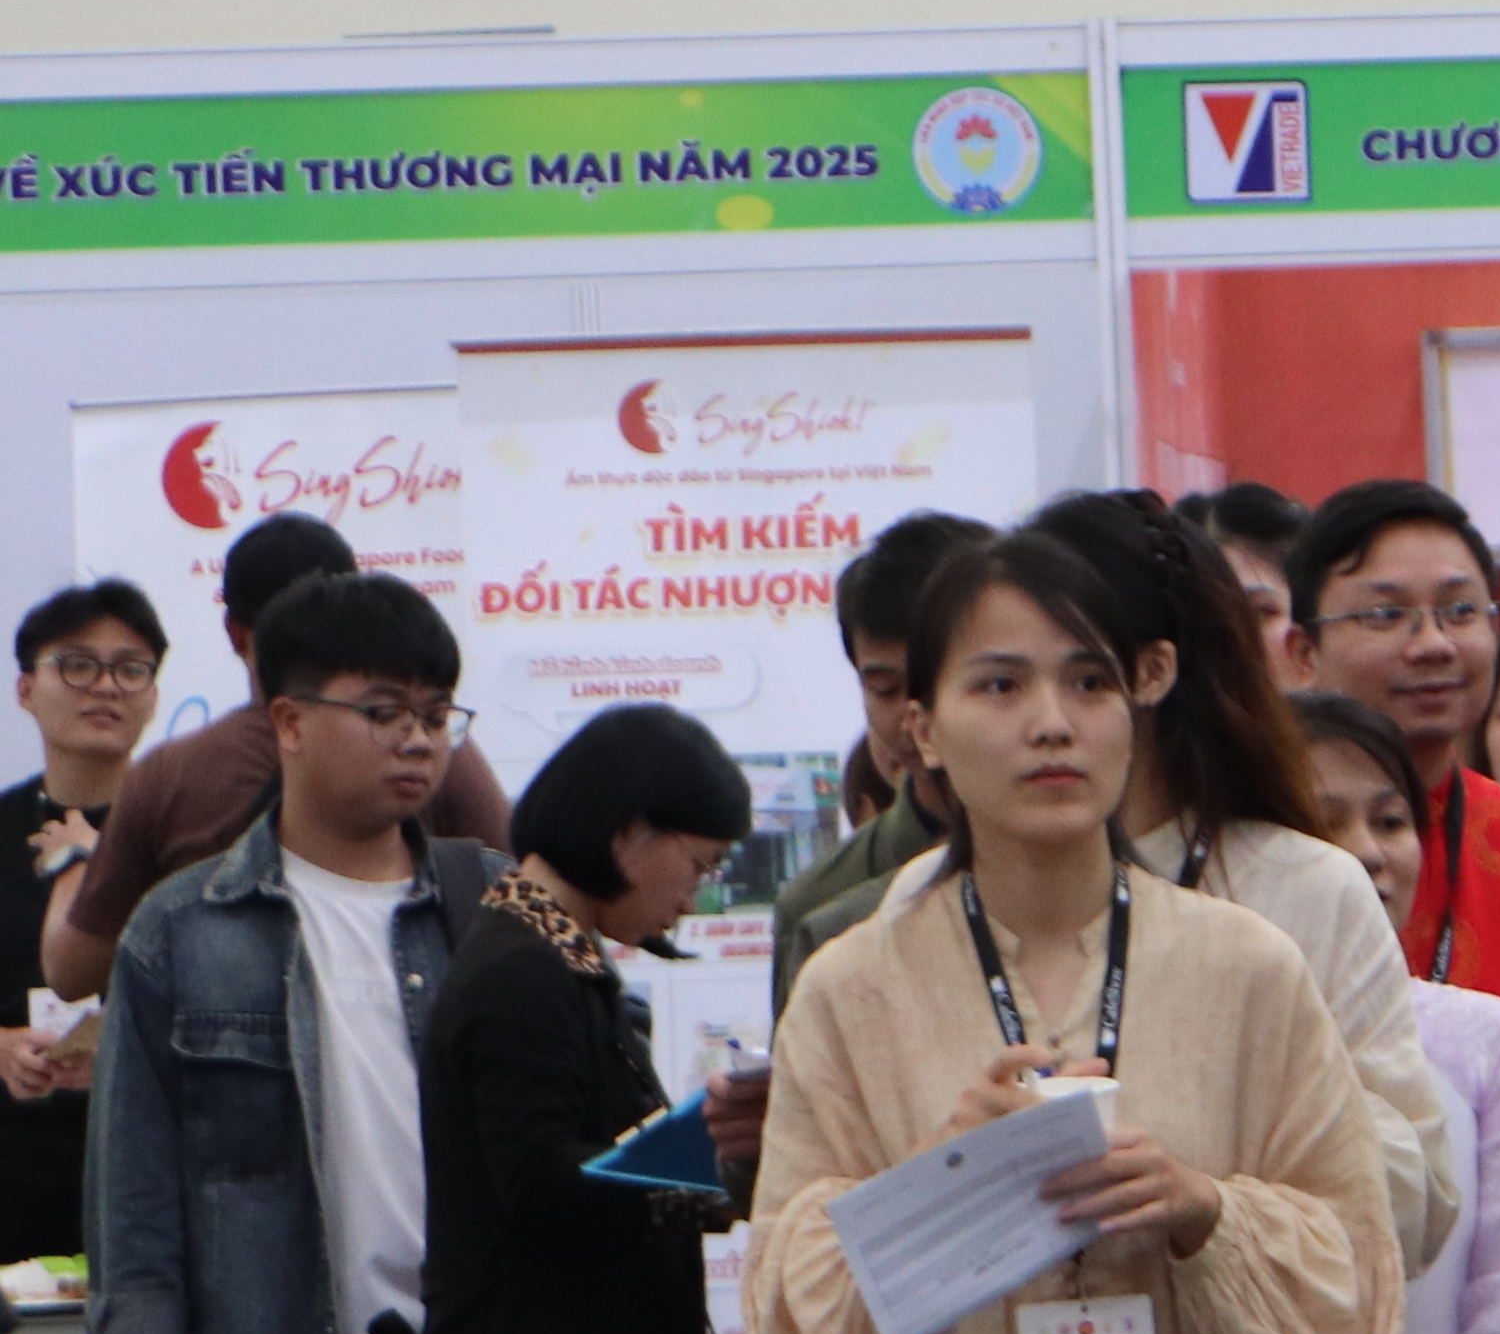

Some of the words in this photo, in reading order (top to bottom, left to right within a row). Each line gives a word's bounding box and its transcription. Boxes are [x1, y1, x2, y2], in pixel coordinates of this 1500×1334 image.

[56, 155, 156, 198] XÚC
[173, 147, 285, 195] TIẾN
[301, 150, 512, 191] THƯƠNG
[529, 151, 621, 196] MẠI
[638, 140, 752, 182] NĂM
[766, 145, 878, 179] 2025
[645, 503, 729, 552] TÌM
[743, 493, 859, 549] KIẾM
[480, 561, 561, 614] ĐỐI
[573, 566, 650, 610] TÁC
[662, 572, 834, 617] NHƯỢN
[571, 680, 620, 697] LINH
